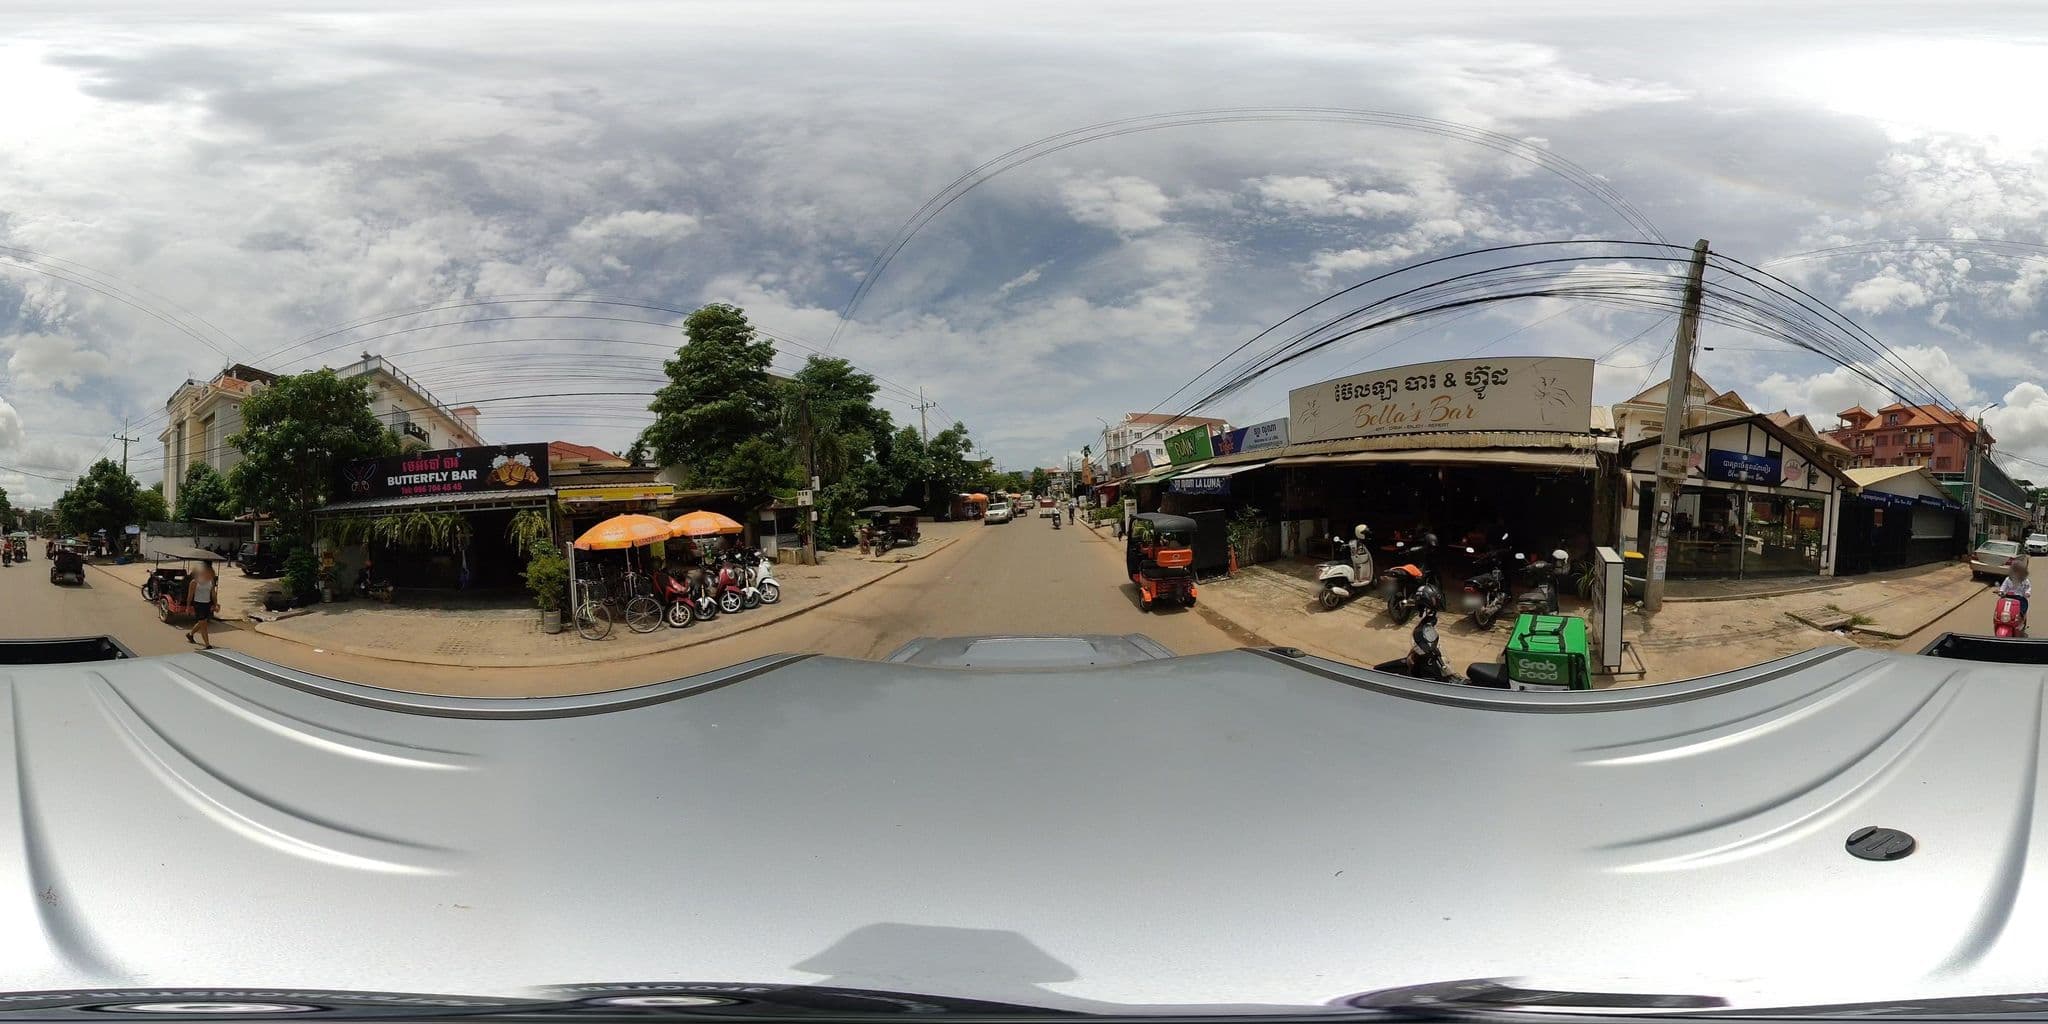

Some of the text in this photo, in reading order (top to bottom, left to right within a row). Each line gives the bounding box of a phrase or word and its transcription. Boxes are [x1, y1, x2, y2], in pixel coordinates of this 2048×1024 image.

[1444, 372, 1456, 388] &
[1354, 395, 1478, 428] Bella's Bar
[387, 470, 477, 486] BUTTERFLY BAR
[1519, 658, 1557, 671] Grab
[1519, 668, 1558, 680] Food
